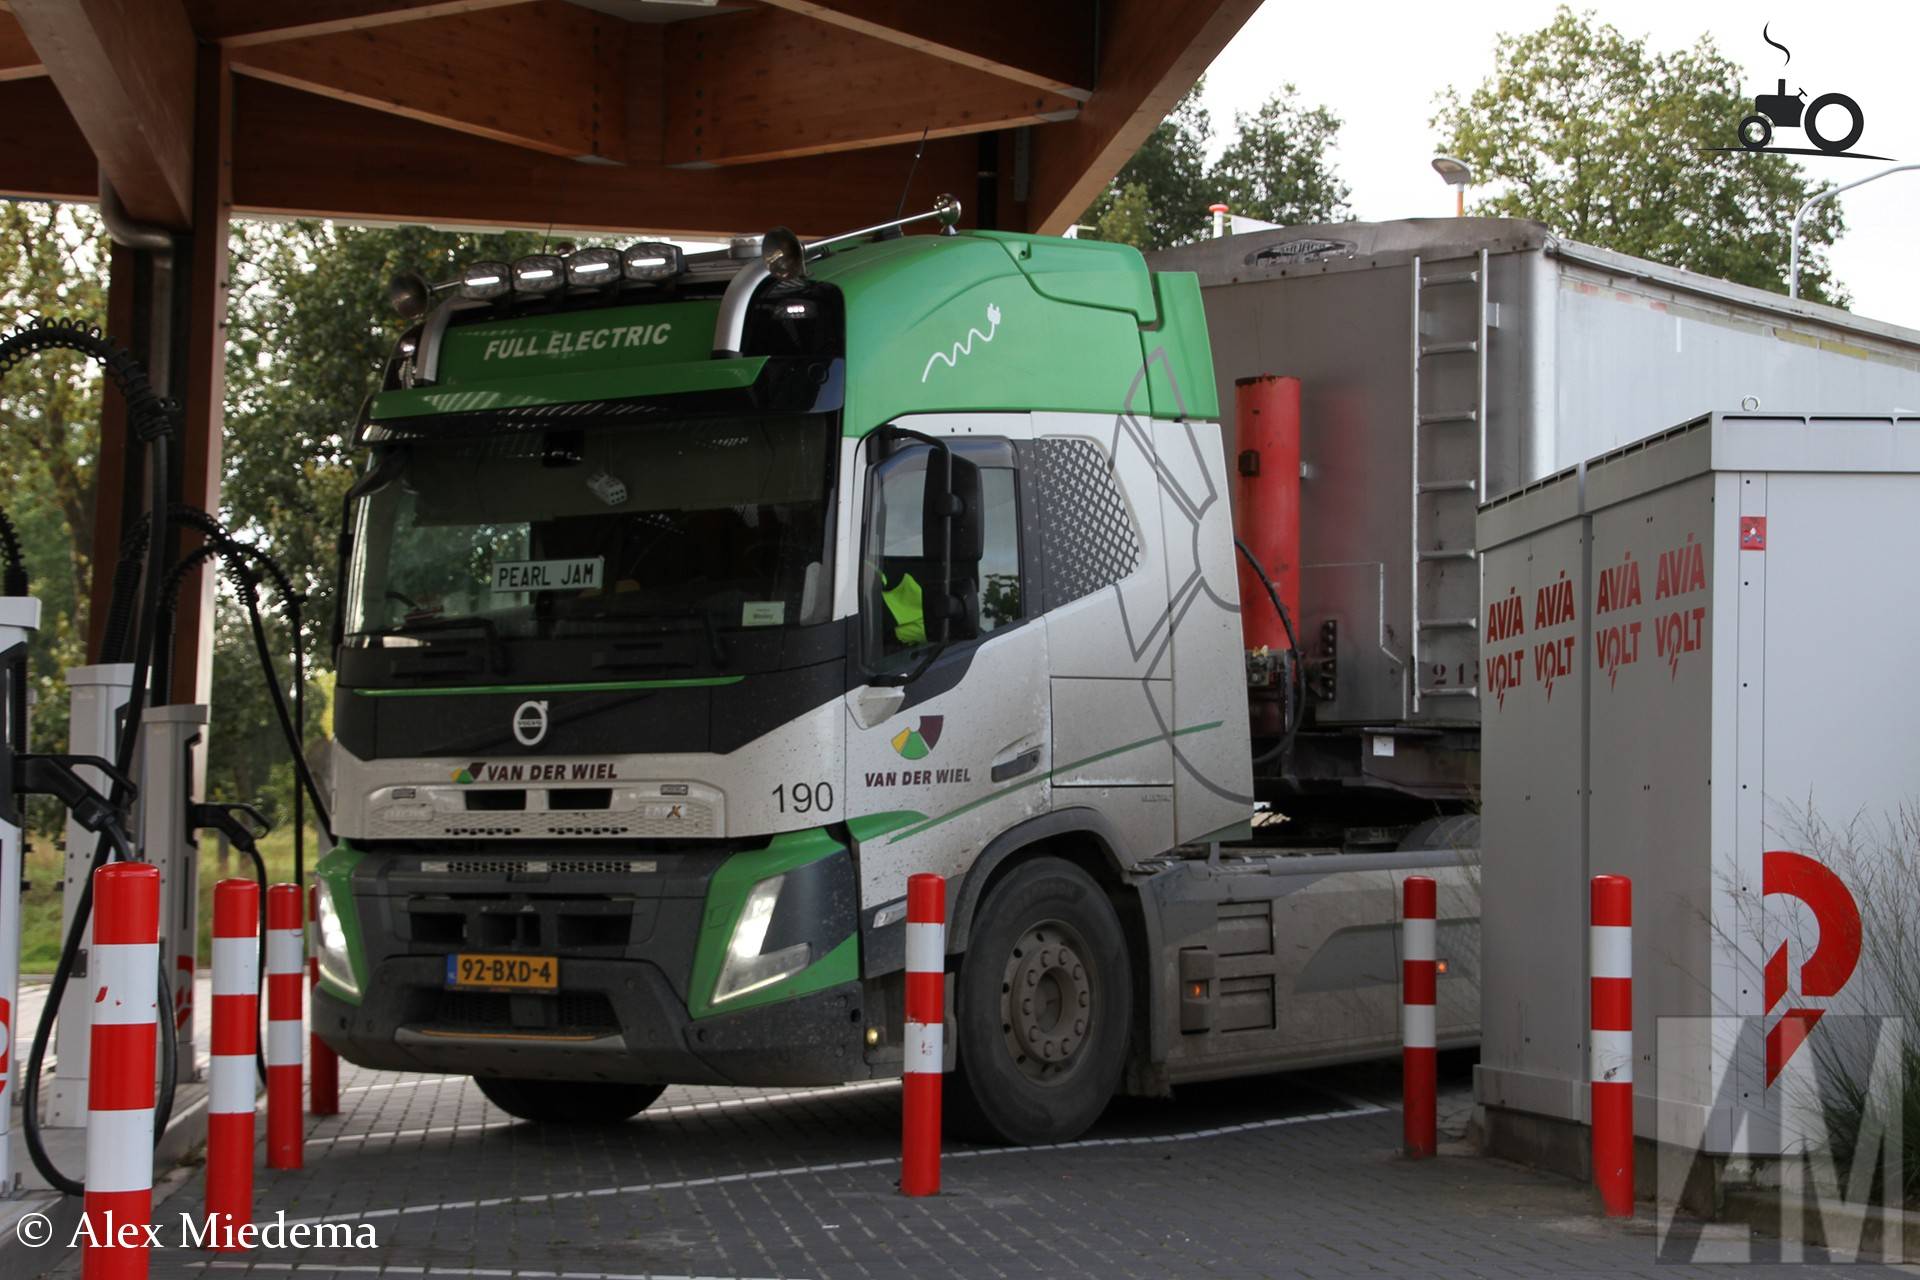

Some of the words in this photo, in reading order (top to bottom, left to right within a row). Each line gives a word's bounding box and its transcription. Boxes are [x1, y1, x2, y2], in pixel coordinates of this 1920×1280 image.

[483, 336, 539, 361] FULL
[546, 323, 672, 355] ELECTRIC
[498, 565, 552, 588] PEARL
[561, 563, 594, 585] JAM
[1596, 621, 1642, 690] VOLT
[1655, 607, 1706, 680] VOLT
[1486, 649, 1524, 709] VOLT
[1534, 636, 1575, 701] VOLT
[487, 765, 524, 781] VAN
[529, 764, 567, 781] DER
[572, 763, 618, 780] WIEL
[865, 772, 897, 787] VAN
[901, 770, 932, 786] DER
[936, 768, 972, 784] WIEL
[772, 782, 833, 813] 190
[462, 958, 552, 983] 92-BXD-4
